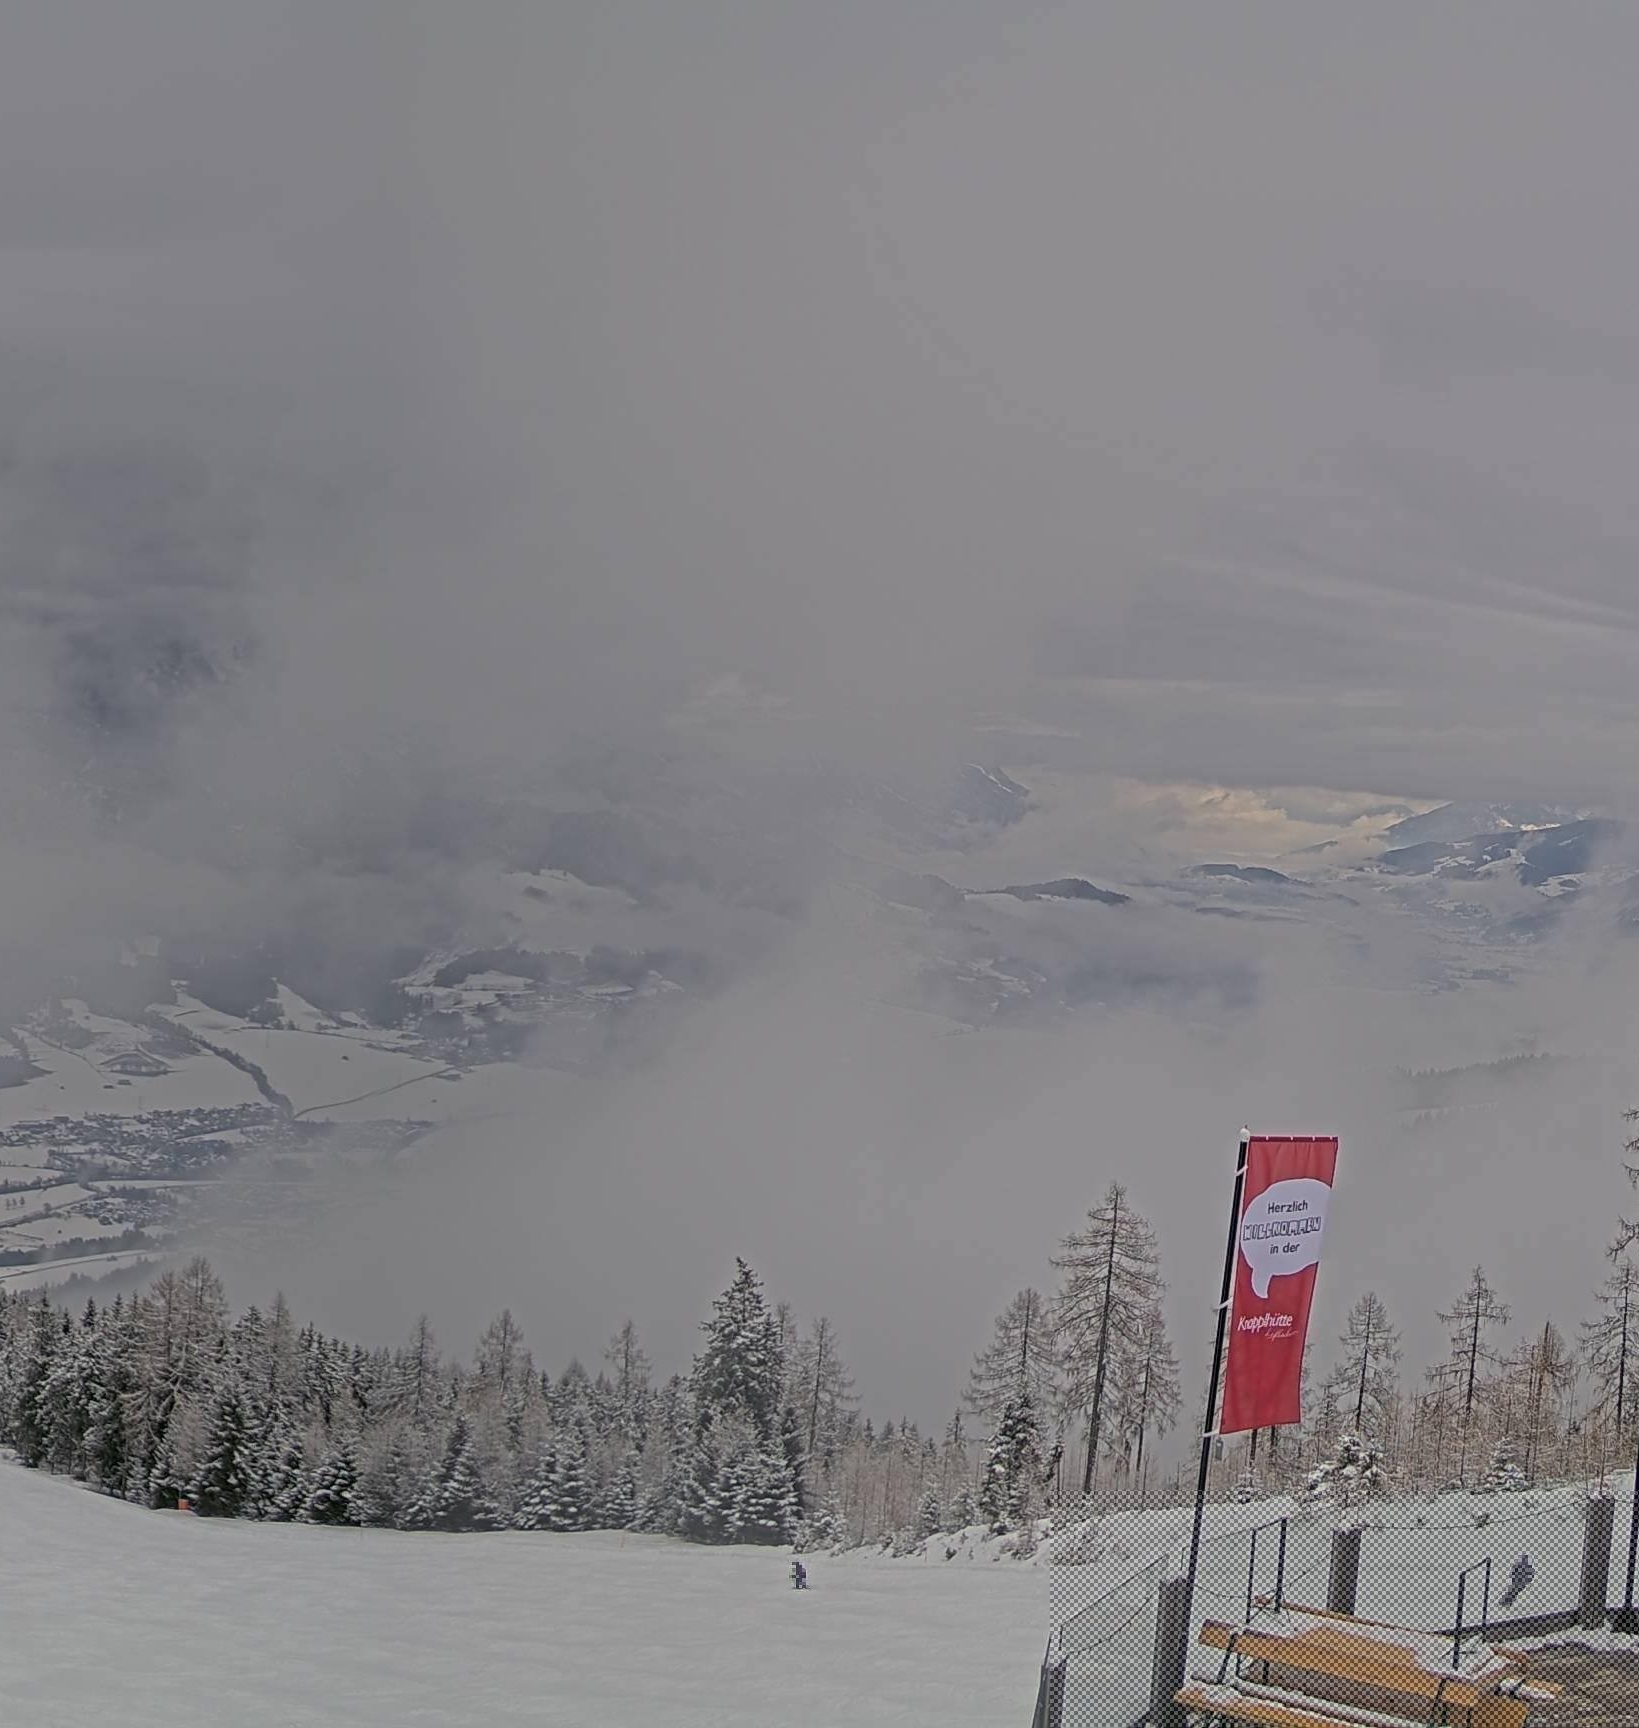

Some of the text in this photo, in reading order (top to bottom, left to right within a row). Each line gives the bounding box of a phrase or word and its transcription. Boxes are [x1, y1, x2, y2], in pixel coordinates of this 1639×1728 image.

[1267, 1200, 1308, 1214] Herzlich
[1242, 1216, 1322, 1241] WILLKOMMEN
[1269, 1242, 1300, 1254] in der
